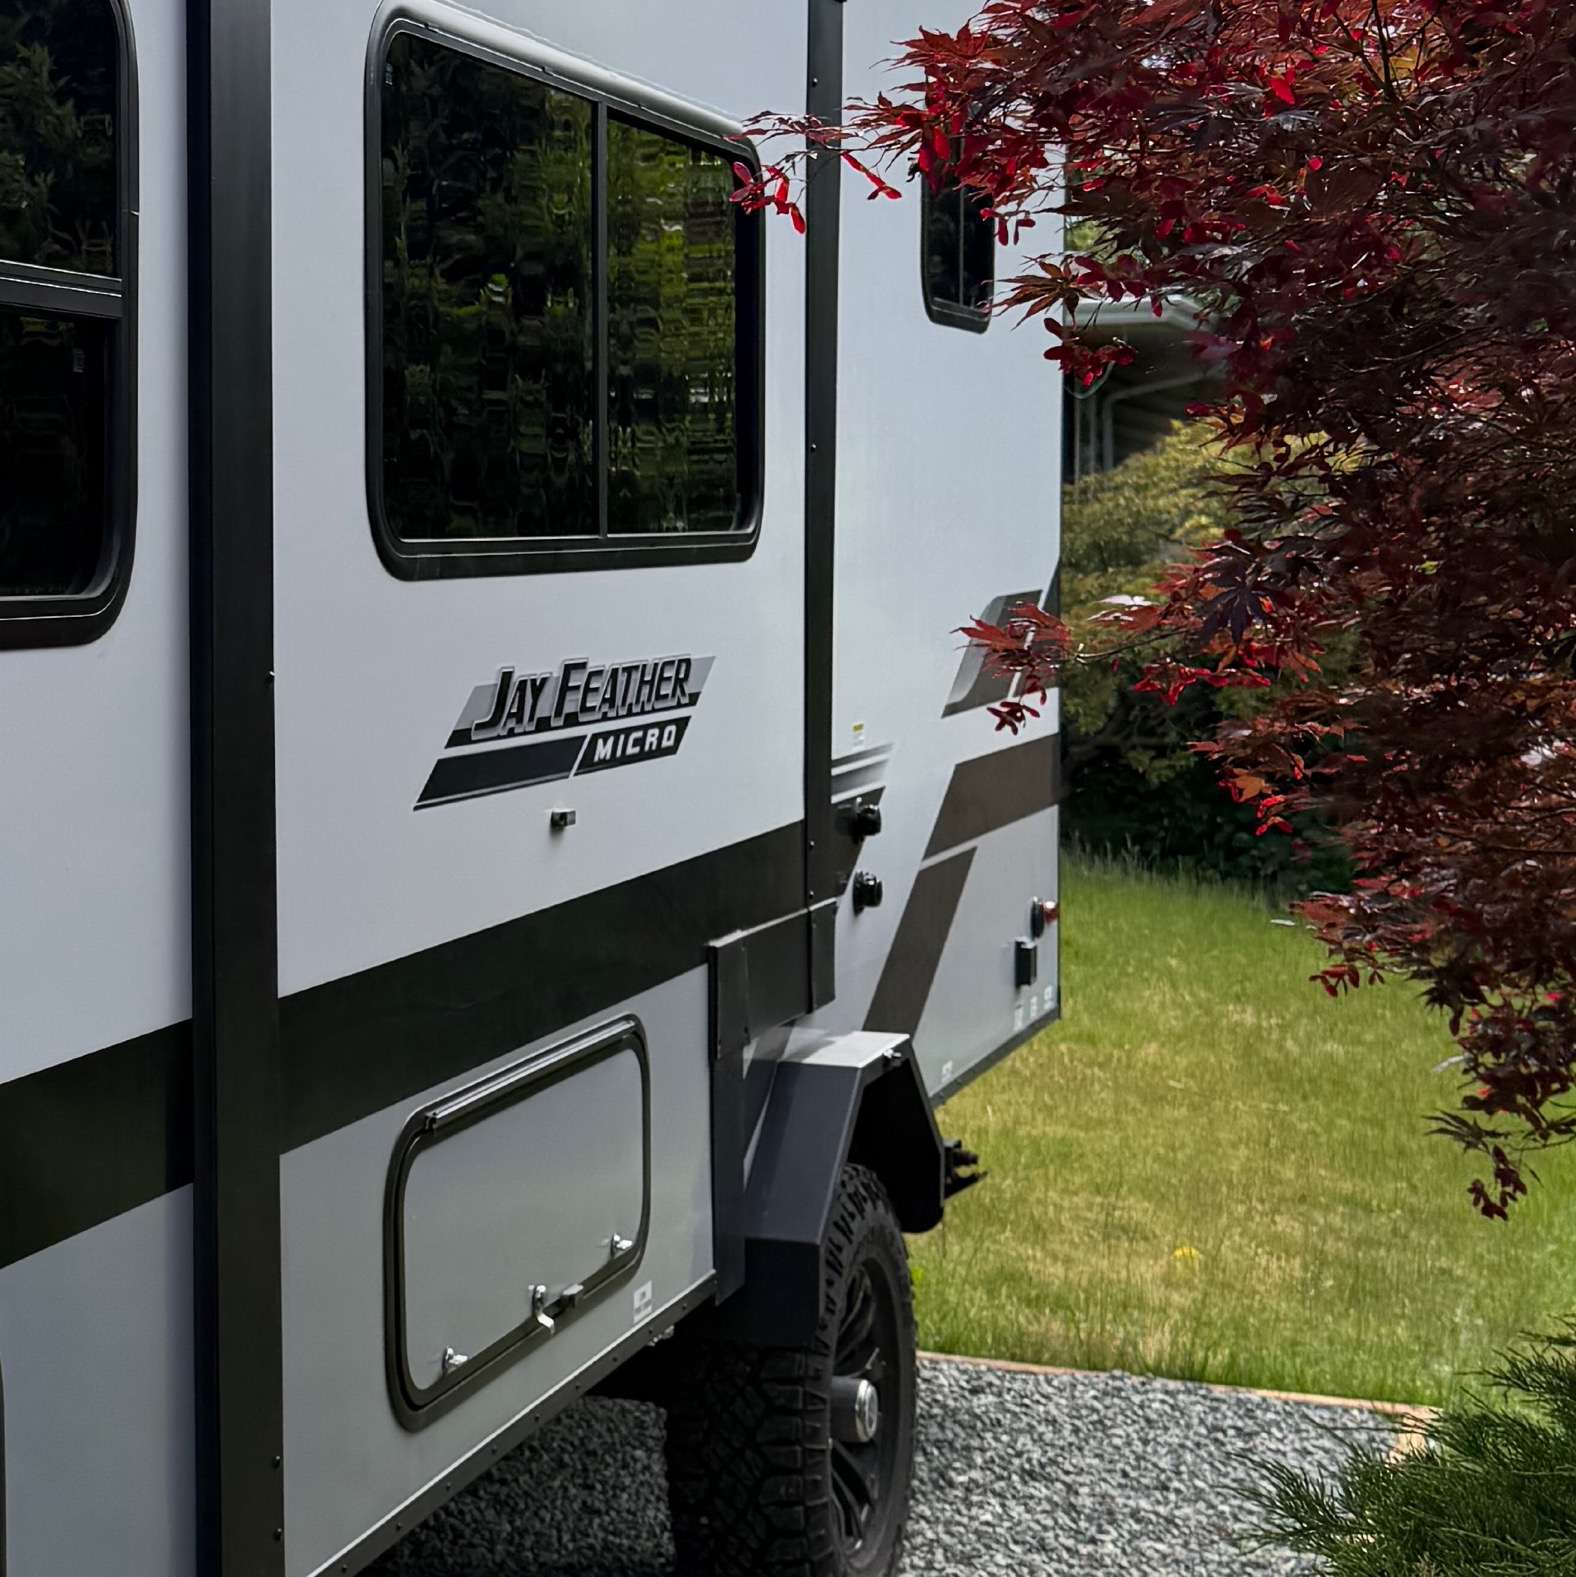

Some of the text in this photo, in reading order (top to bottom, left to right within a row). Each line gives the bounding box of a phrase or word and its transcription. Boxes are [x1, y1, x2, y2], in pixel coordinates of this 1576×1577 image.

[472, 653, 692, 739] JAY FEATHER
[593, 725, 677, 763] MICRO
